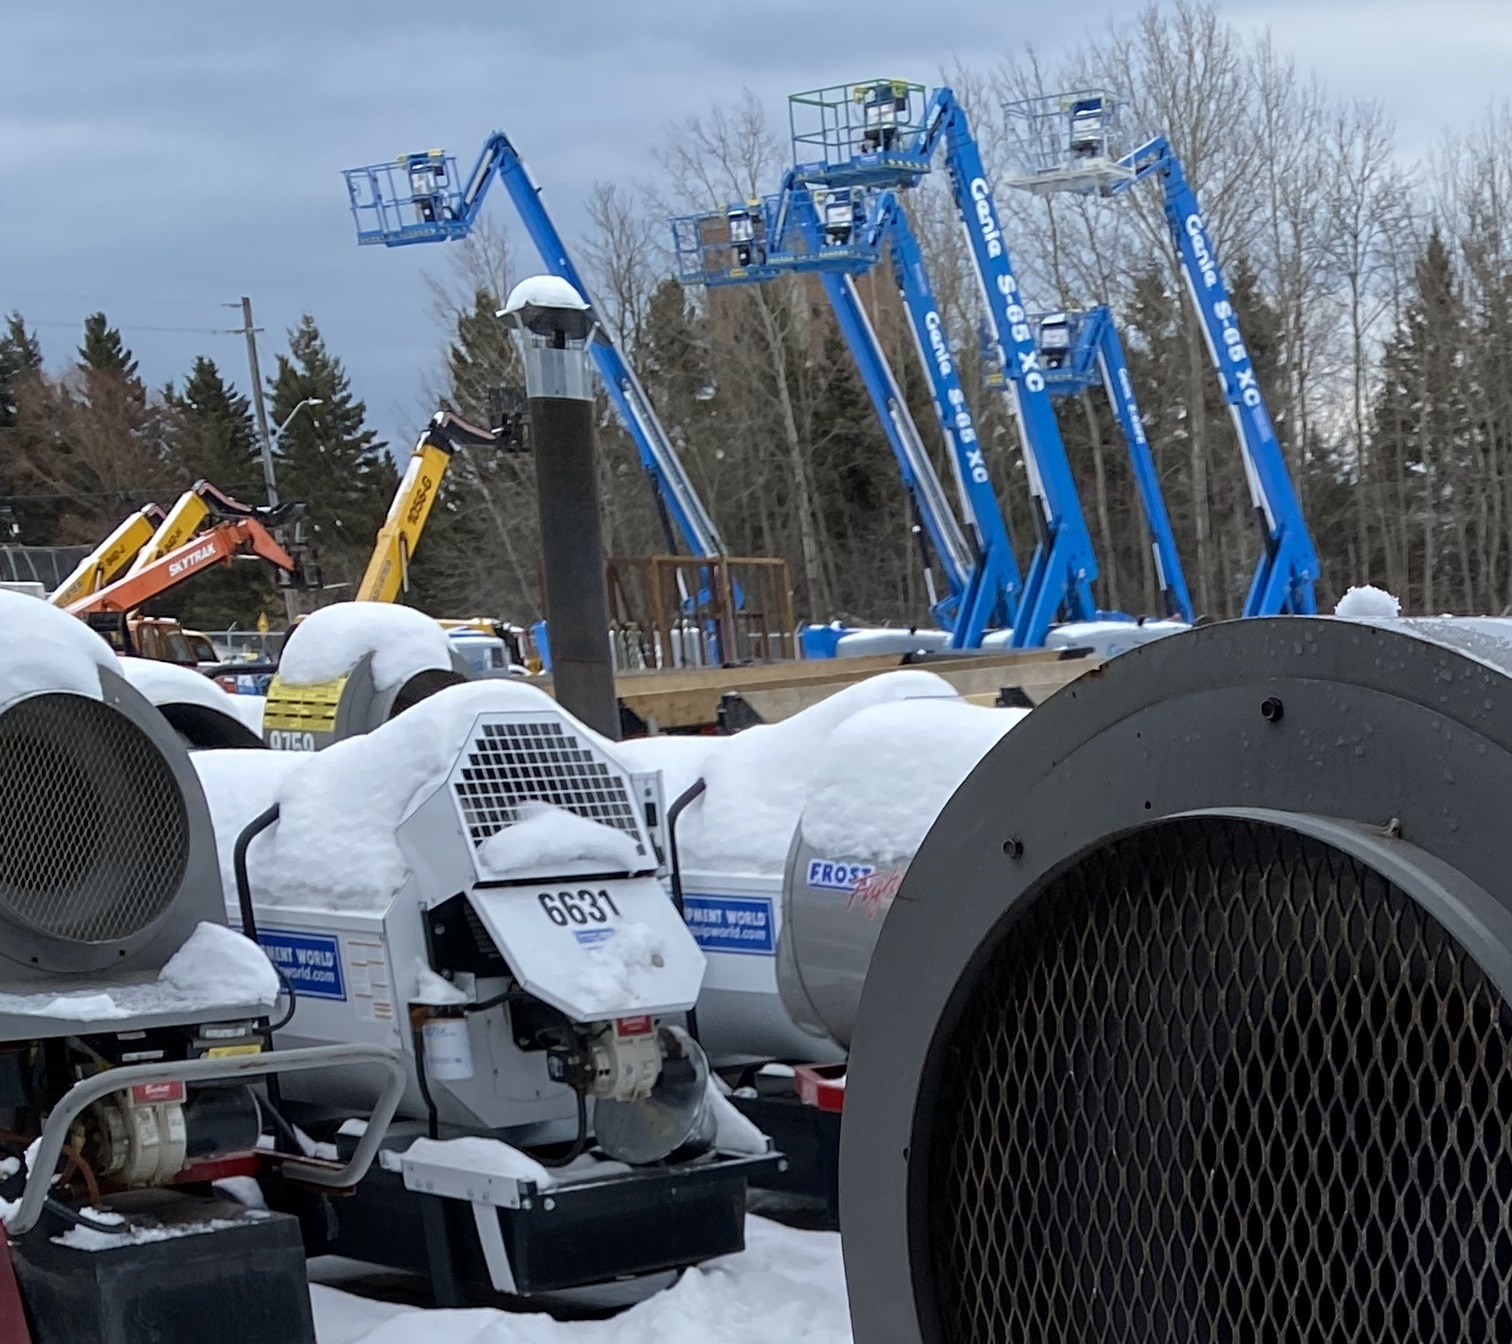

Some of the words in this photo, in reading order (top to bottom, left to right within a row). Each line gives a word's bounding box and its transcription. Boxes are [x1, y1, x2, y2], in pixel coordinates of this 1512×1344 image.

[970, 177, 1002, 259] Genie
[997, 274, 1032, 343] S-65
[1185, 214, 1217, 288] Genie
[1213, 301, 1247, 362] S-65
[925, 311, 951, 376] Genie
[948, 388, 976, 444] S-65
[169, 543, 216, 577] SKYTRAK
[809, 861, 872, 886] FROST
[538, 889, 622, 926] 6631
[726, 909, 766, 926] WORLD
[297, 948, 335, 967] WORLD
